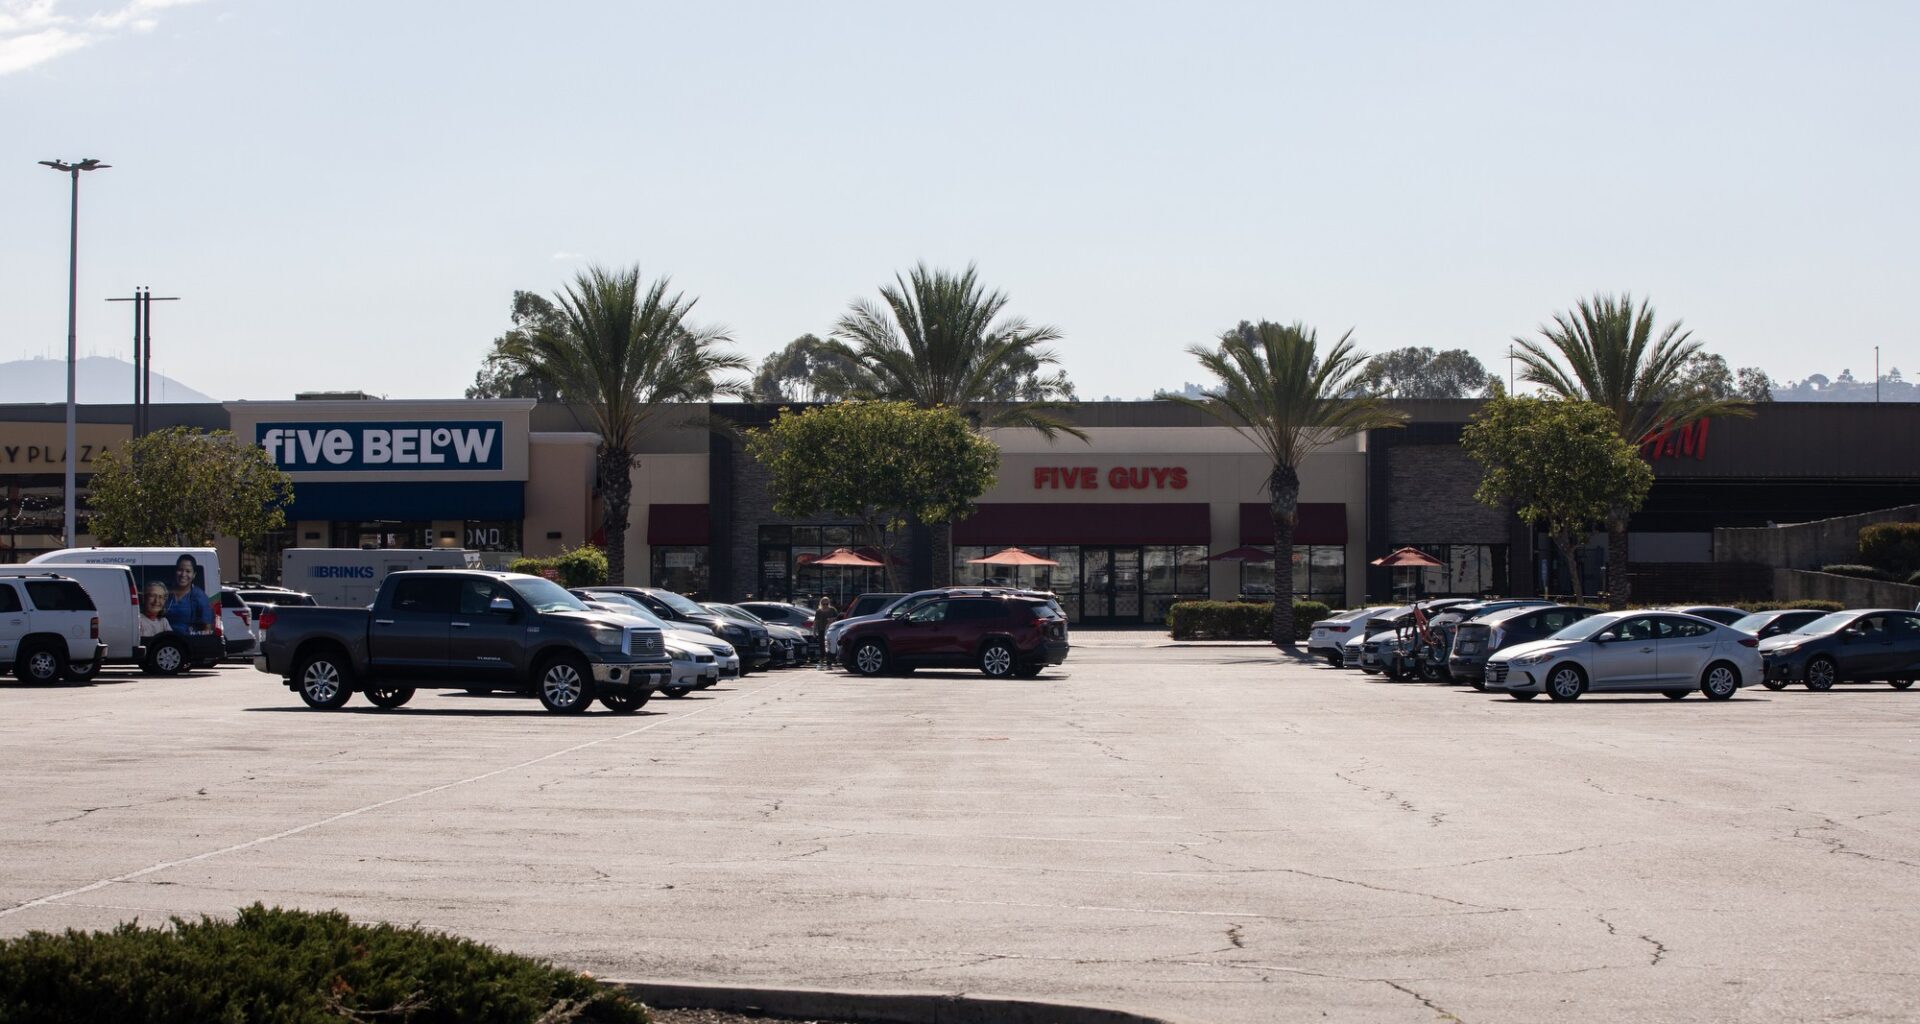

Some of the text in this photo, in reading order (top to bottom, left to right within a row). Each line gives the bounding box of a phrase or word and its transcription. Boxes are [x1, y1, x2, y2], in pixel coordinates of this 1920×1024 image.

[262, 428, 353, 464] five
[1034, 467, 1188, 489] FIVE GUYS
[319, 566, 374, 578] BRINKS
